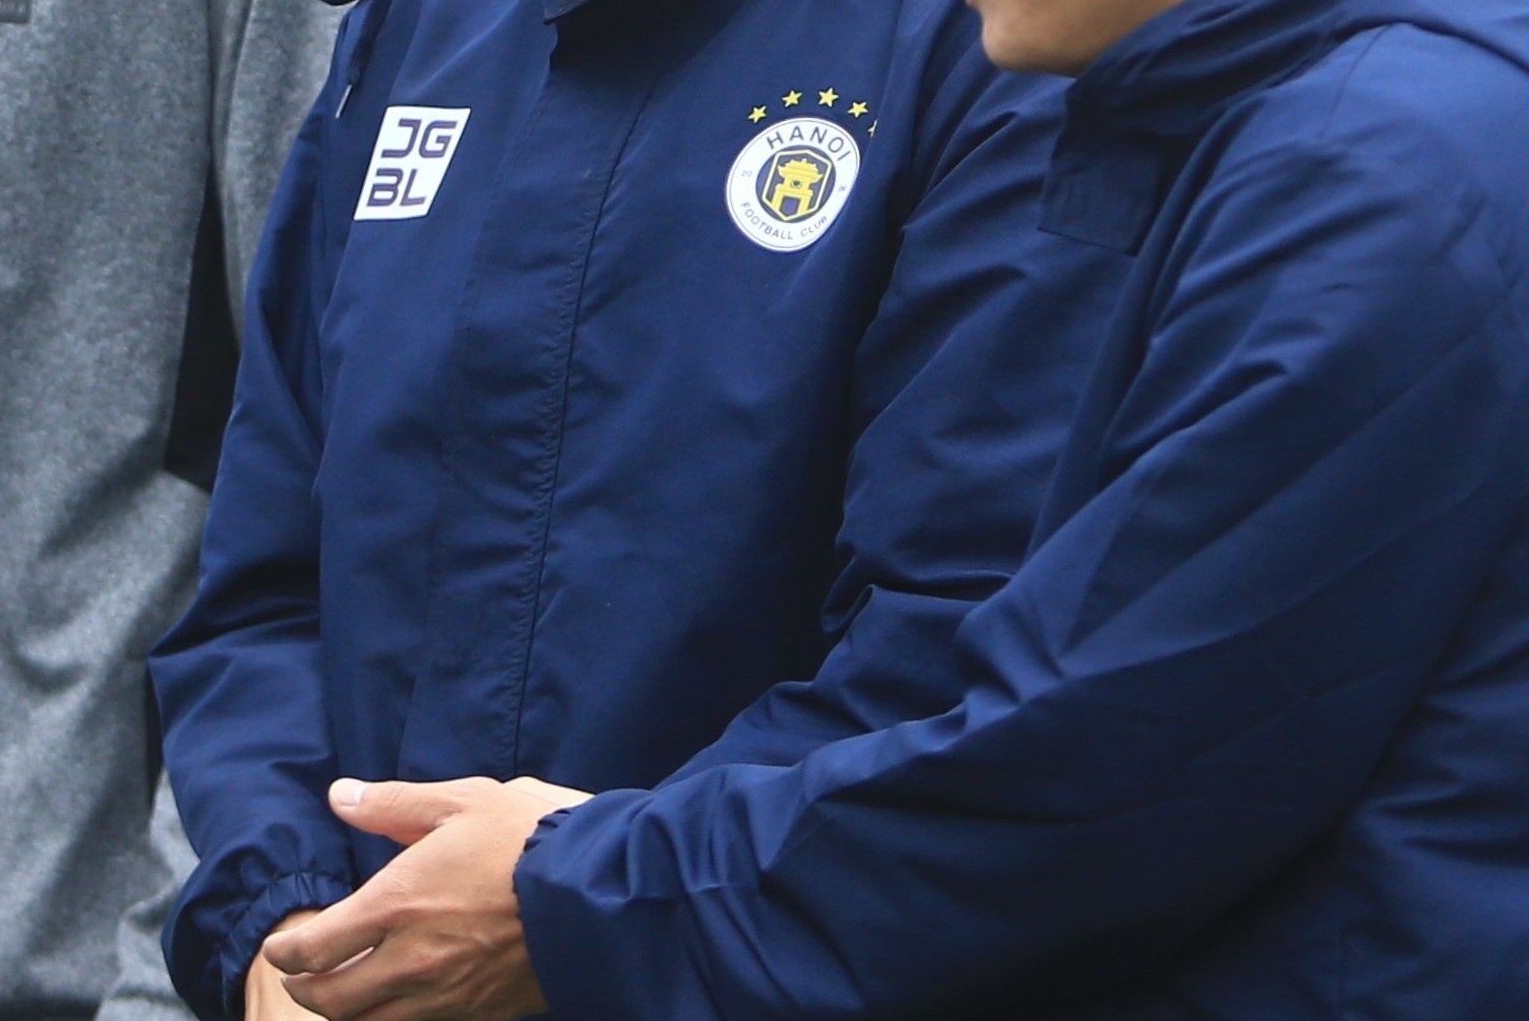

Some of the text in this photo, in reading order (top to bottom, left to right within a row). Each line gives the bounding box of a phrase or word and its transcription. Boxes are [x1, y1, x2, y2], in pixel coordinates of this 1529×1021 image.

[381, 118, 459, 158] JG
[766, 125, 851, 161] HANOI
[366, 168, 428, 207] BL
[741, 201, 794, 240] FOOTBALL
